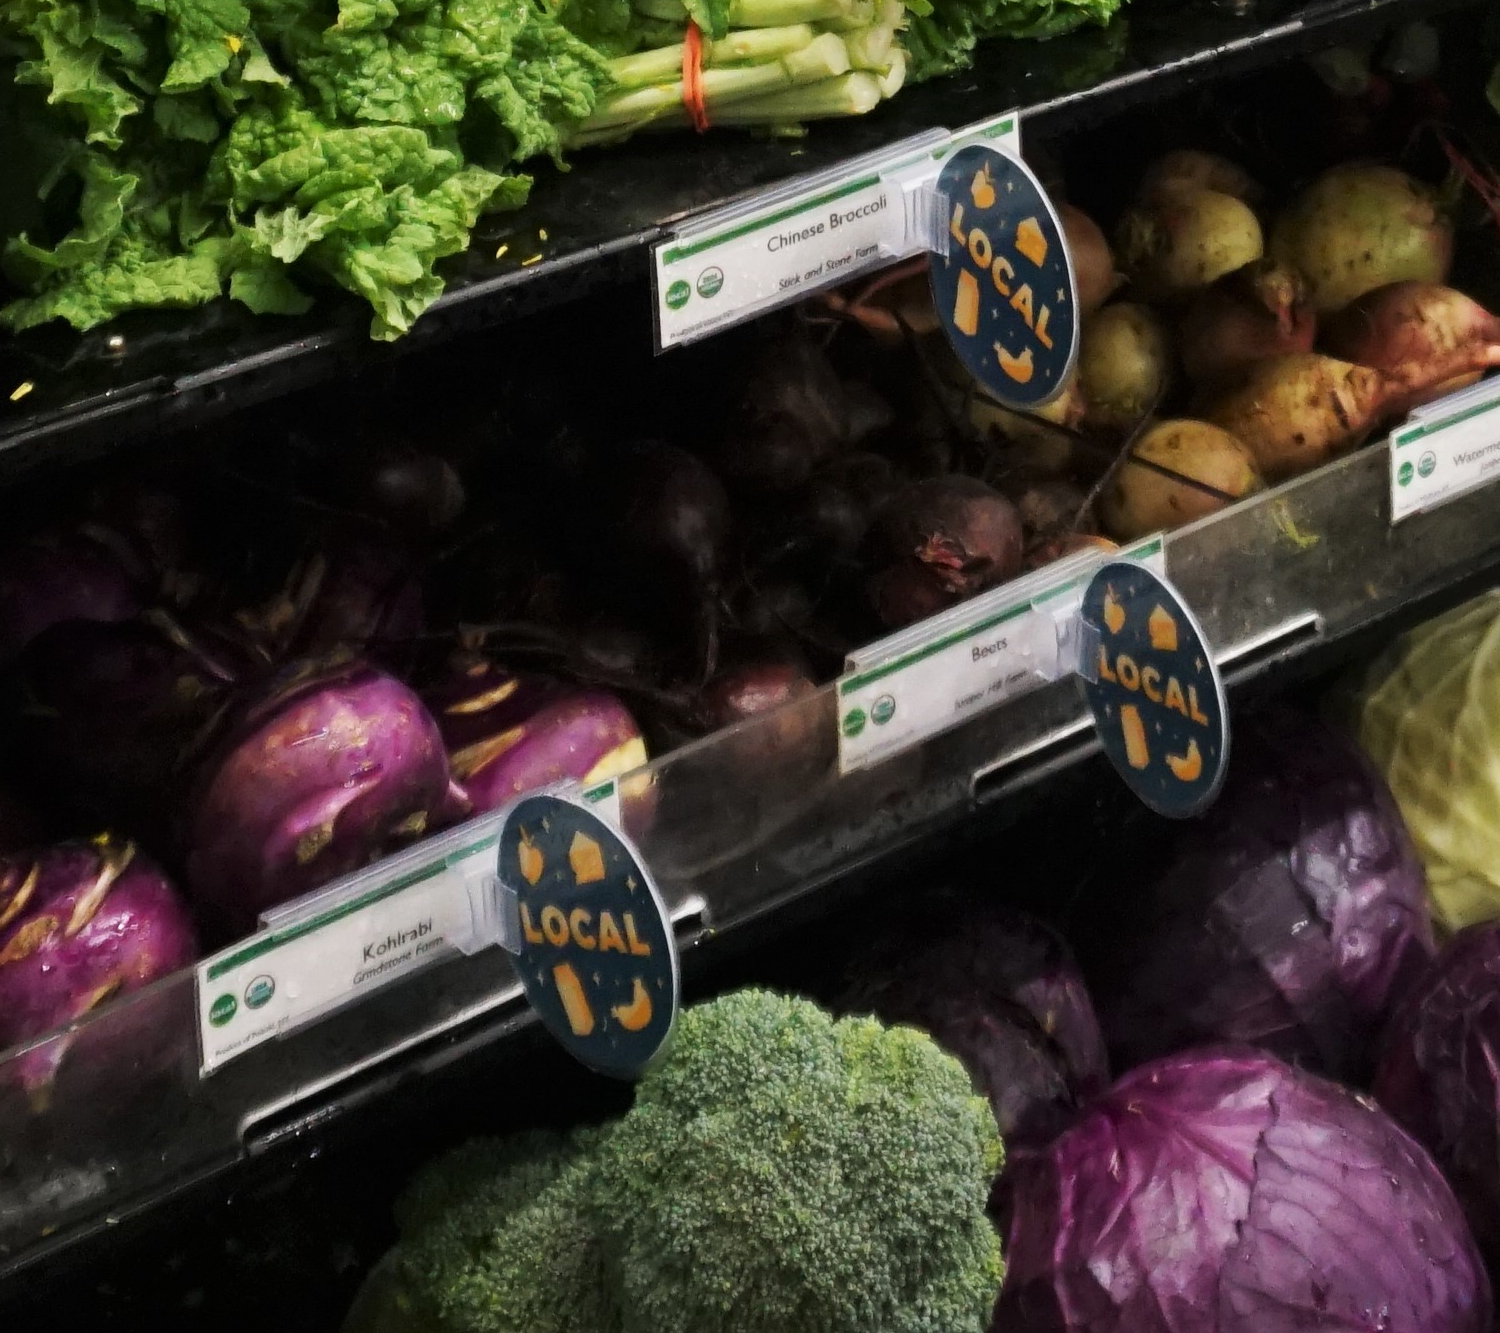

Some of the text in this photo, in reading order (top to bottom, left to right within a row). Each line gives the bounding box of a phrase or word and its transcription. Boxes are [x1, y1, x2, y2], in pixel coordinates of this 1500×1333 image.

[767, 194, 888, 254] Chinese Broccoli
[779, 242, 879, 292] Stick and Stone Farm
[951, 202, 1053, 350] LOCAL
[971, 637, 1008, 663] Beets
[1100, 644, 1209, 726] LOCAL
[362, 918, 433, 963] Kohlrabi
[520, 902, 651, 957] LOCAL
[353, 935, 444, 986] Grindstone Farm
